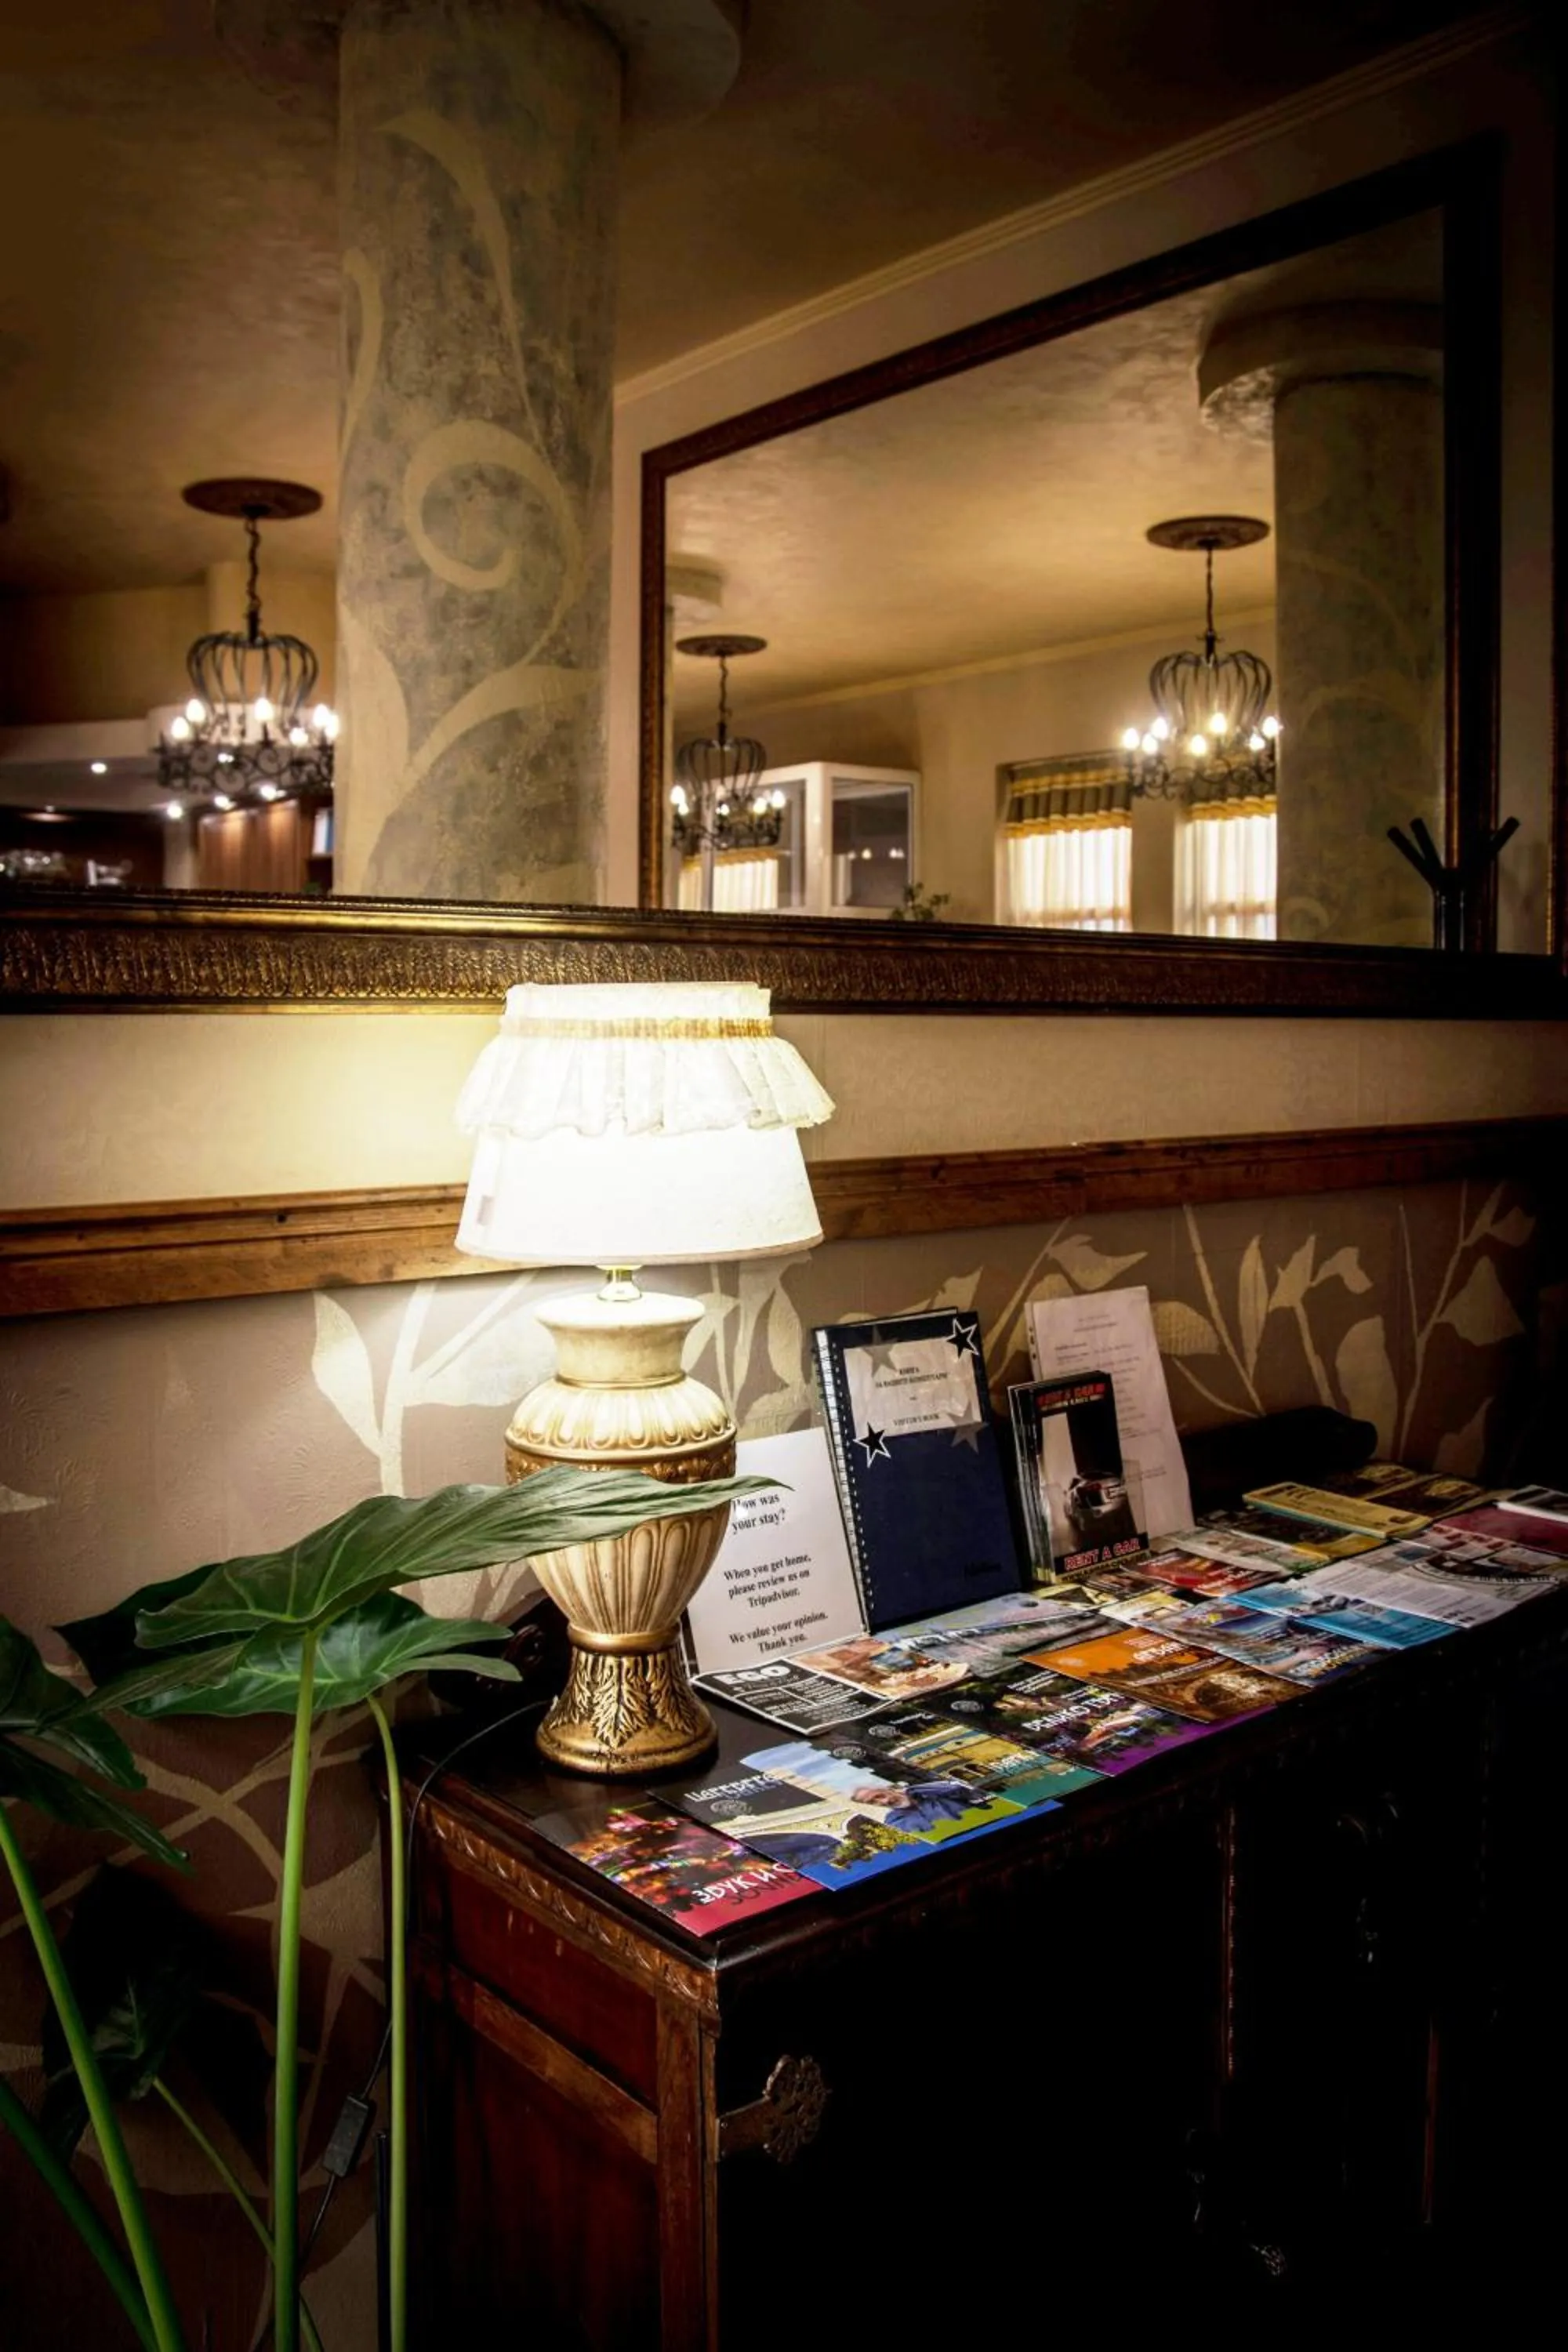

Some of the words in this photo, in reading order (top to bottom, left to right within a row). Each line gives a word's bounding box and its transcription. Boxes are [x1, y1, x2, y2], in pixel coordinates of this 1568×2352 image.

[760, 1493, 780, 1506] was
[731, 1516, 757, 1534] your
[759, 1508, 786, 1526] stay?
[1064, 1548, 1099, 1570] RENT
[1102, 1545, 1112, 1560] A
[1113, 1537, 1141, 1556] CAR
[724, 1566, 750, 1581] When
[752, 1563, 769, 1577] you
[771, 1559, 784, 1573] get
[728, 1582, 757, 1599] please
[757, 1574, 785, 1589] review
[787, 1572, 798, 1581] us
[798, 1569, 810, 1580] on
[747, 1586, 800, 1608] Tripadvisor.
[729, 1632, 745, 1644] We
[746, 1626, 771, 1640] value
[771, 1620, 792, 1635] your
[793, 1610, 829, 1628] opinion.
[757, 1636, 787, 1654] Thank
[787, 1632, 808, 1647] you.
